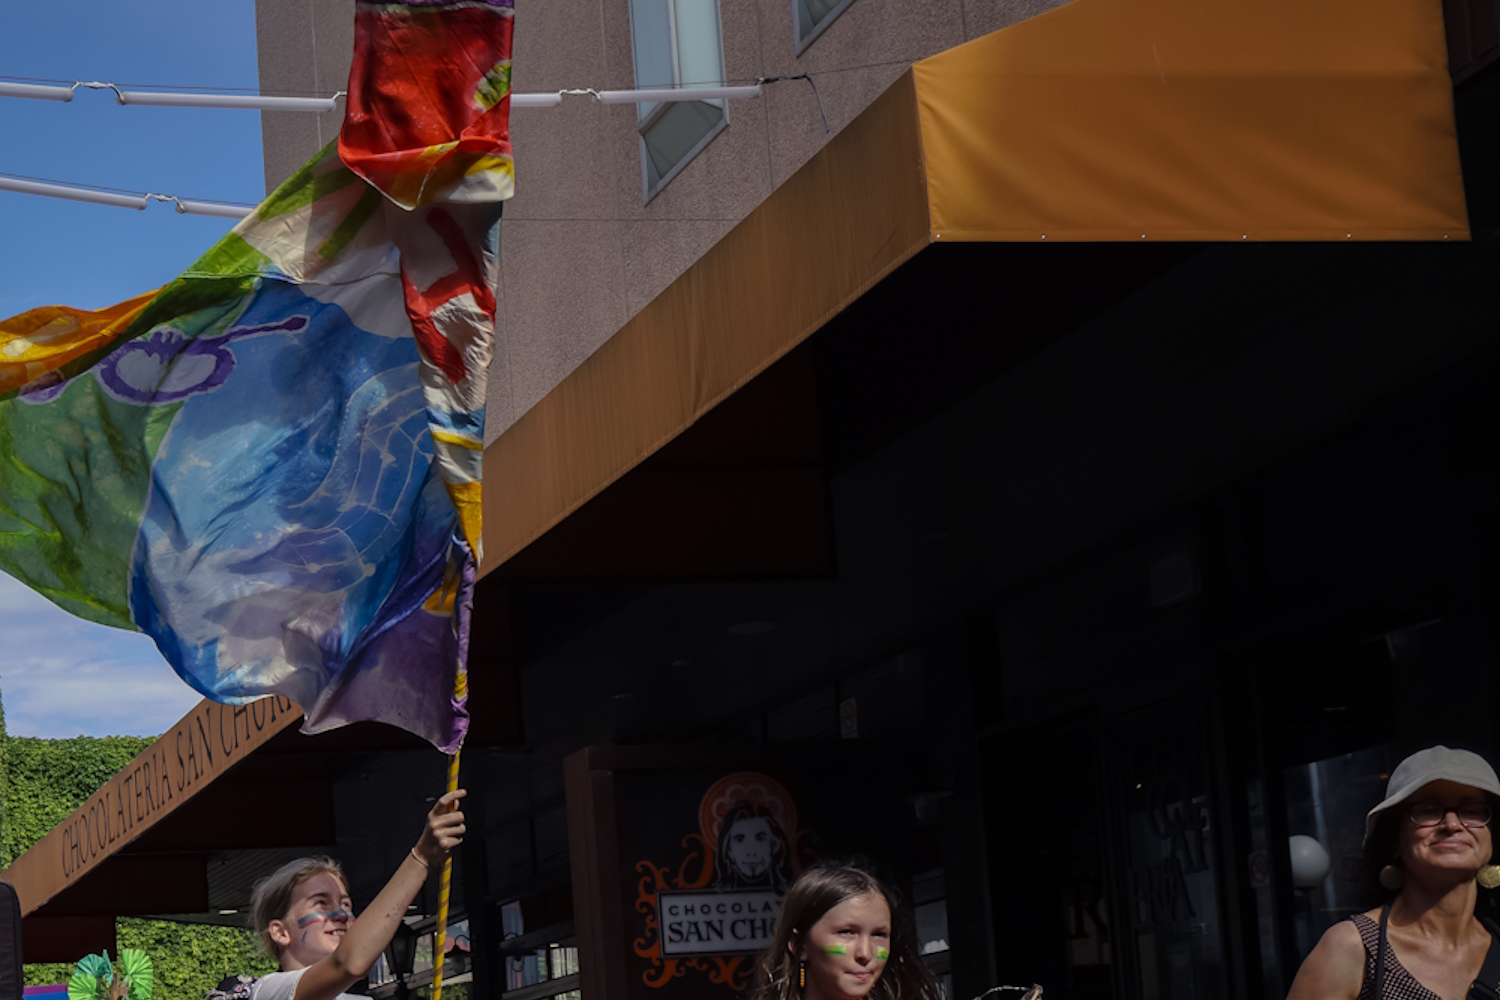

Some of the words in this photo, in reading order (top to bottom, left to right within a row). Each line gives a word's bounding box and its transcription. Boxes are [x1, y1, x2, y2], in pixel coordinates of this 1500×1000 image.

[62, 745, 173, 878] CHOCOLATERIA
[176, 705, 214, 791] SAN
[668, 919, 725, 944] SAN
